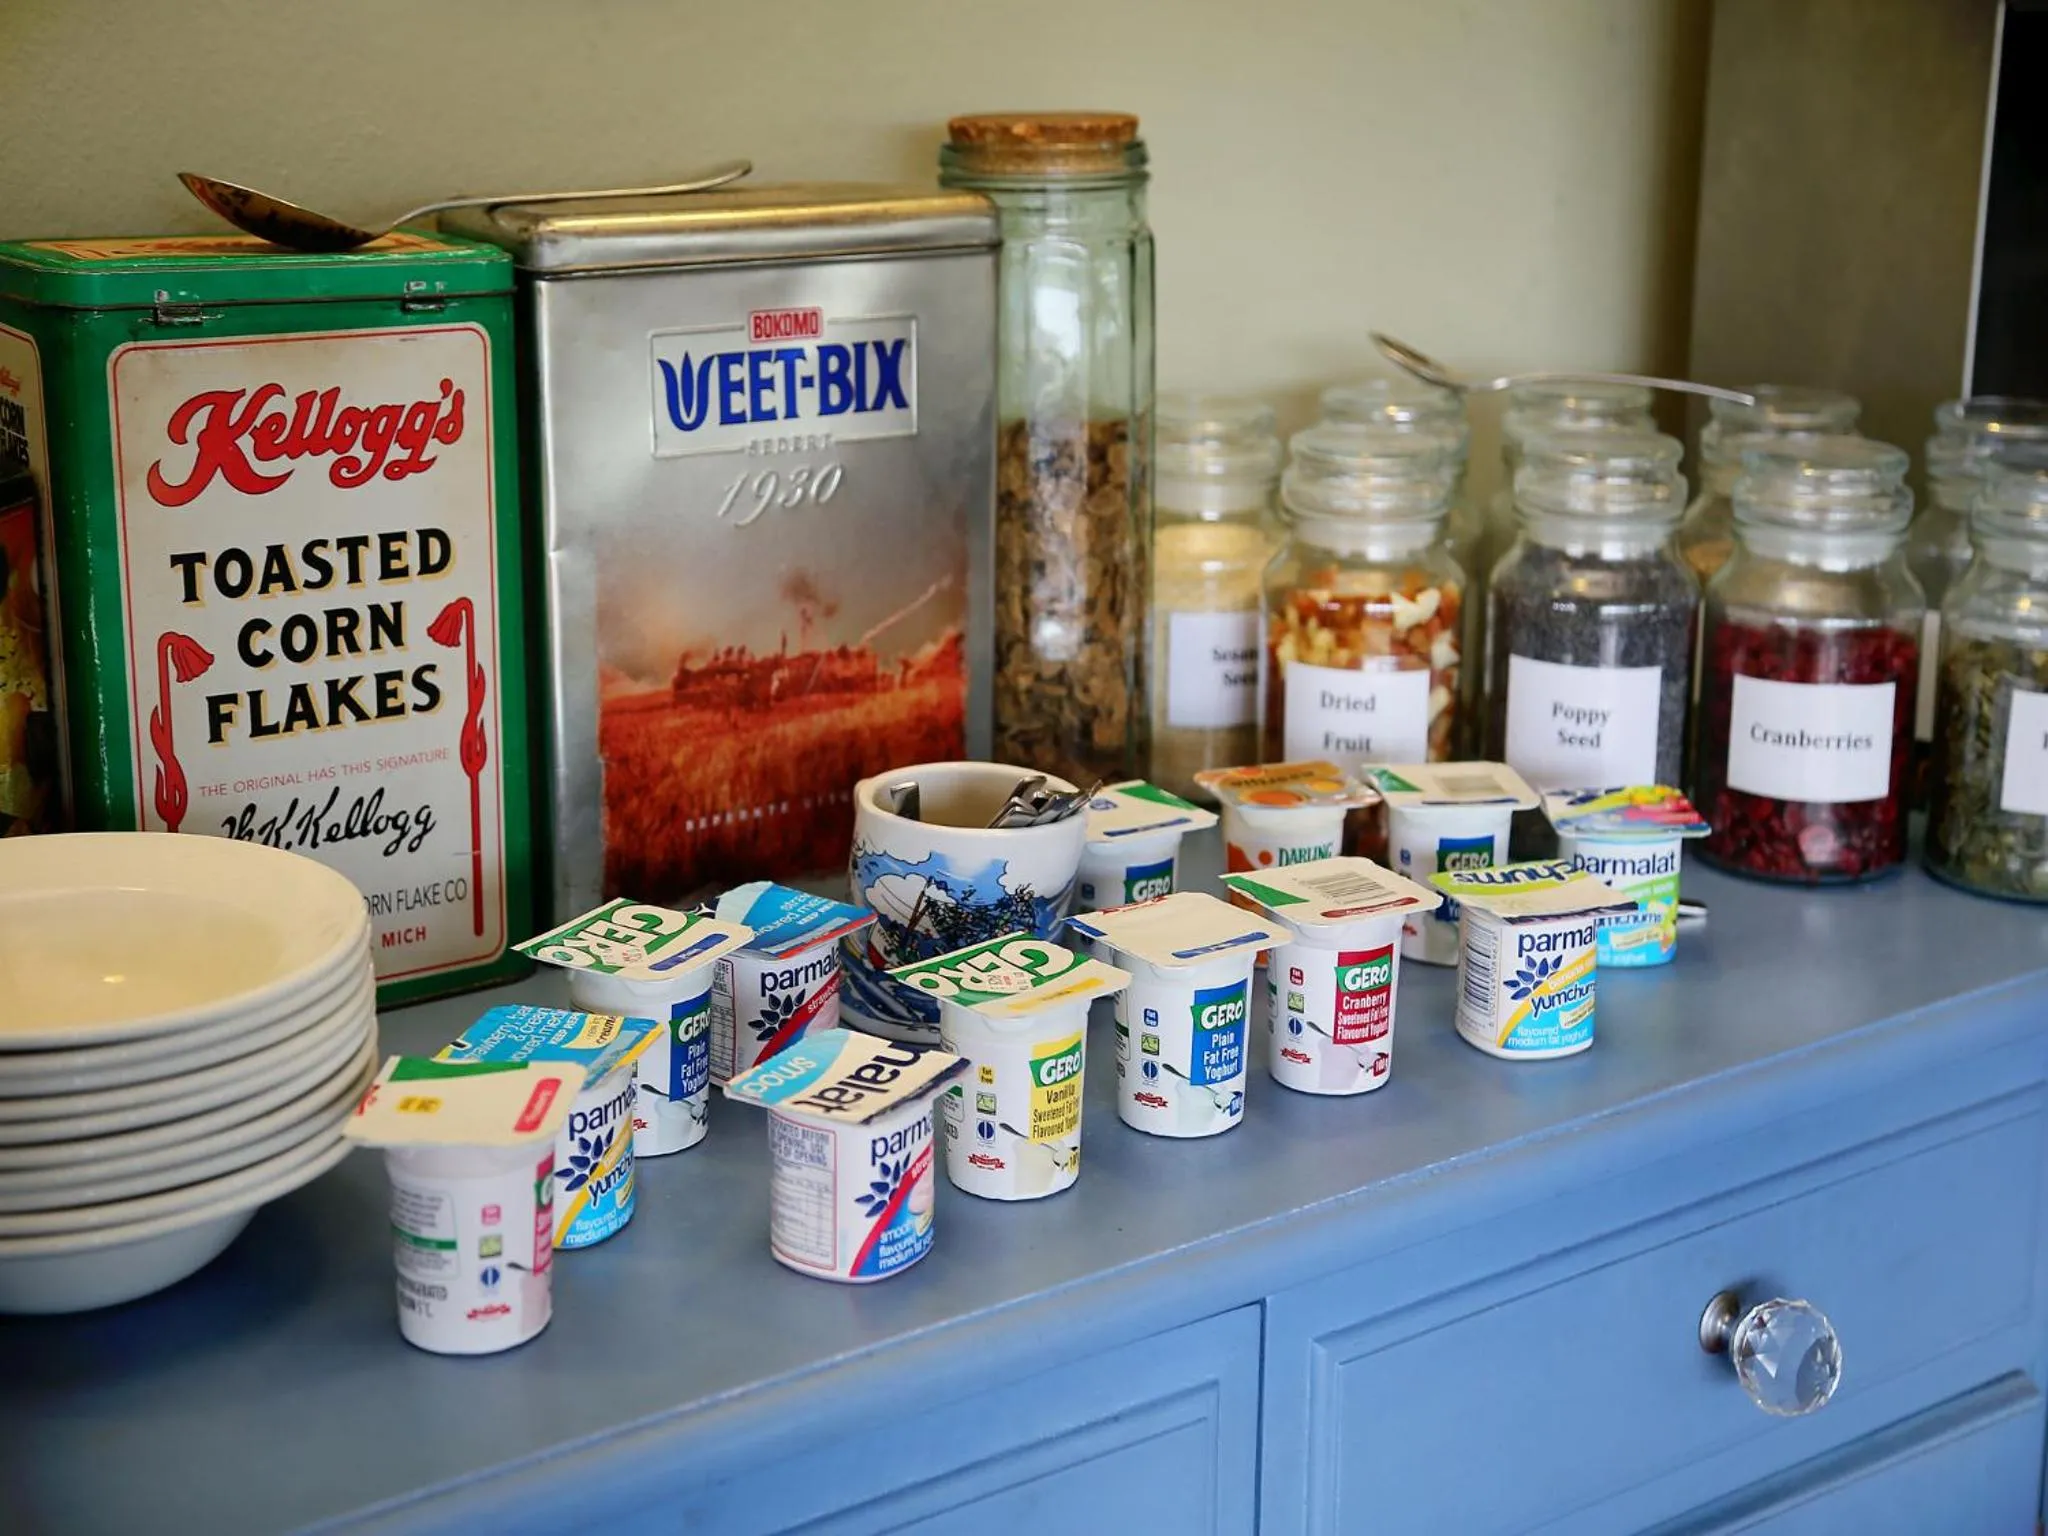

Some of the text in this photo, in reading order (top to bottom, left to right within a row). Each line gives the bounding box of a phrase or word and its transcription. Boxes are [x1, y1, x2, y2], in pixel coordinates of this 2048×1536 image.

[752, 311, 820, 340] BOKOMO
[657, 338, 910, 432] WEET-BIX
[147, 378, 465, 507] Kellogg's
[716, 464, 845, 528] 1930
[170, 527, 456, 604] TOASTED
[237, 600, 408, 670] CORN
[205, 663, 445, 746] FLAKES
[1320, 690, 1377, 712] Dried
[1552, 702, 1611, 726] Poppy
[1322, 731, 1372, 753] Fruit
[1557, 730, 1602, 750] Seed
[1750, 722, 1874, 750] Cranberries
[199, 747, 449, 798] THE ORIGINAL HAS THIS SIGNATURE
[1278, 841, 1335, 867] DARLING
[1444, 851, 1490, 873] GERO
[1453, 860, 1577, 885] chums
[397, 883, 442, 912] FLAKE
[445, 877, 468, 903] CO
[1132, 876, 1171, 902] GERO
[381, 926, 427, 948] MICH
[1518, 919, 1597, 958] parmal
[1344, 963, 1390, 991] GERO
[1343, 990, 1389, 1010] Cranberry
[1200, 999, 1244, 1030] GERO
[1211, 1031, 1236, 1049] Plain
[1039, 1051, 1081, 1085] GERO
[1203, 1045, 1240, 1066] Fat Free
[568, 1082, 635, 1142] parma
